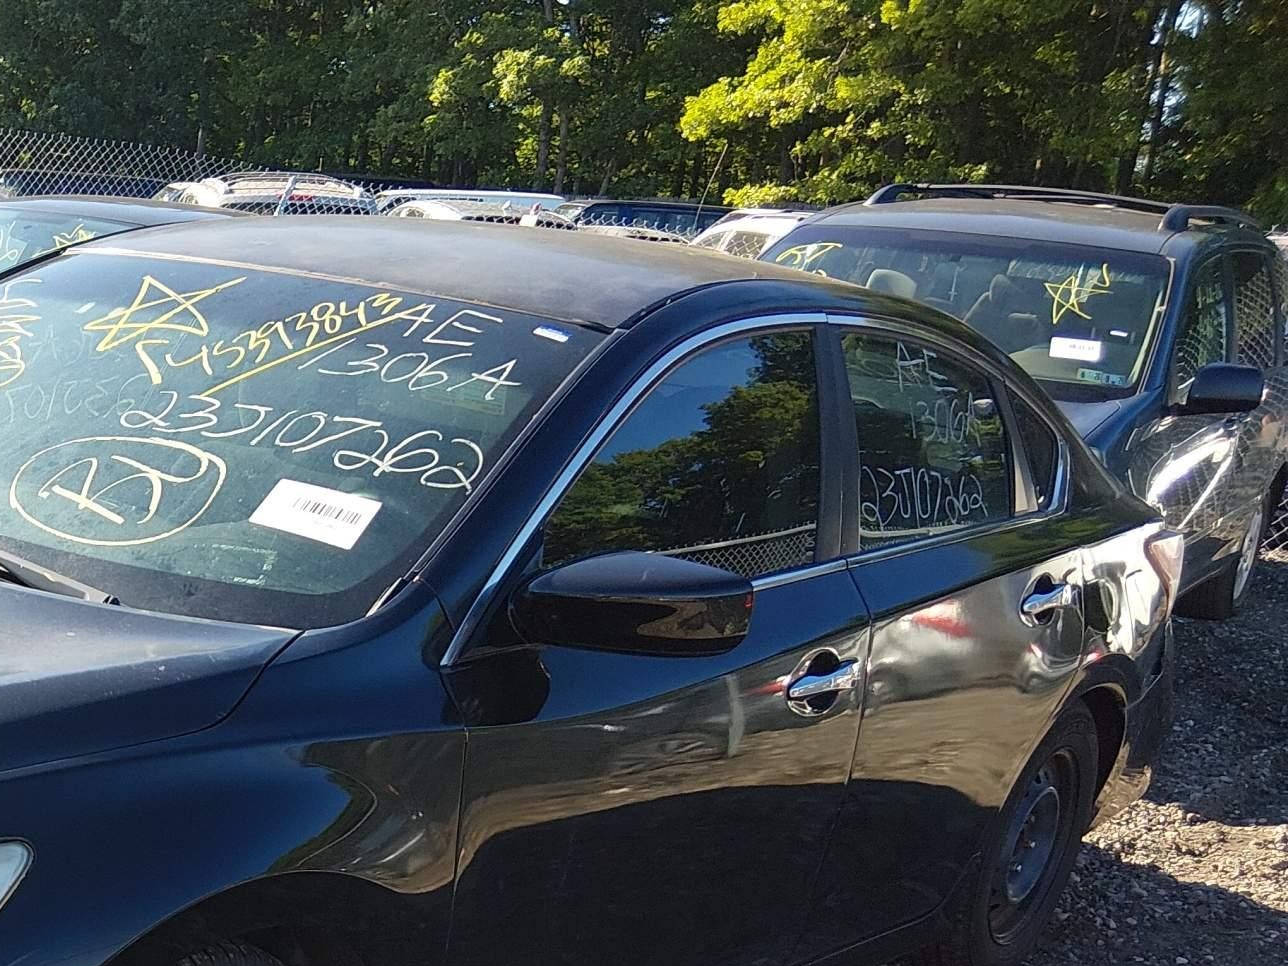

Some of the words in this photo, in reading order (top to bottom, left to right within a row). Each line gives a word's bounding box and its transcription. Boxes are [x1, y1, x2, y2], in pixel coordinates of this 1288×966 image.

[402, 302, 504, 347] AE
[896, 340, 958, 392] AE
[120, 391, 484, 495] 23J107262
[861, 465, 989, 532] 23J107262
